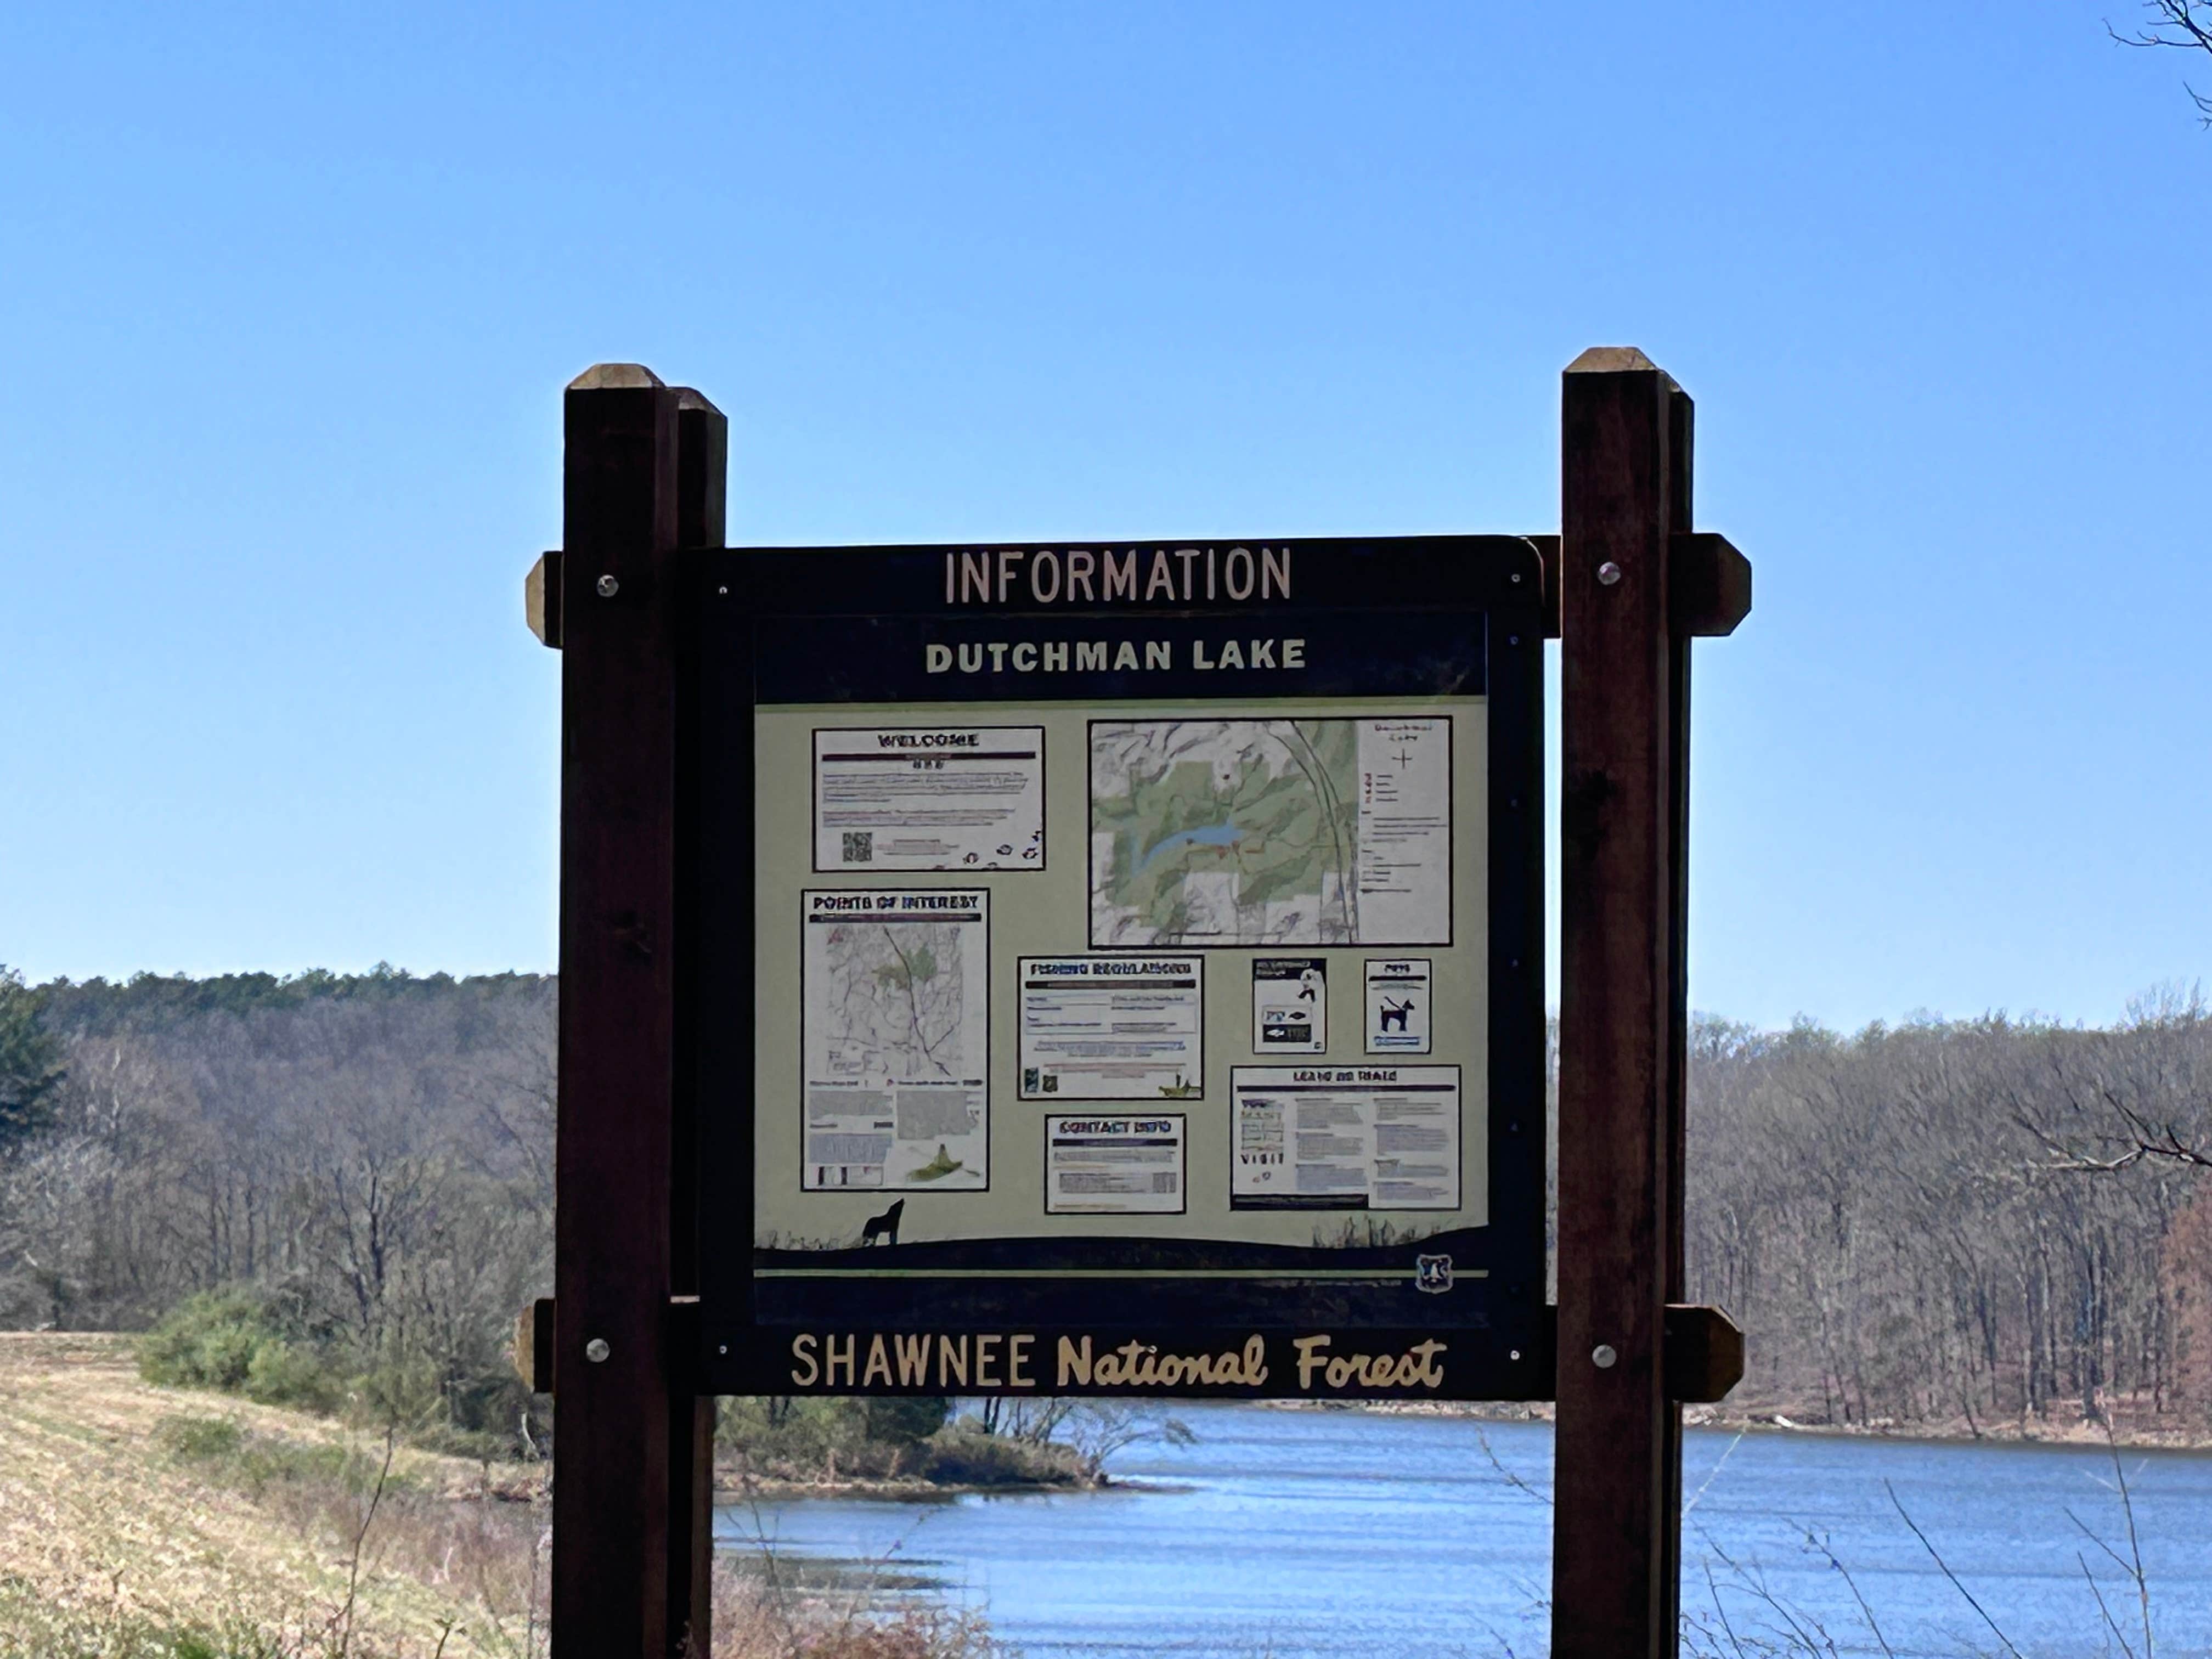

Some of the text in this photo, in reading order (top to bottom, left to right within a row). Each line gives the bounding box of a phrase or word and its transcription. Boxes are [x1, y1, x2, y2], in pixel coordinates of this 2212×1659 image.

[945, 547, 1291, 604] INFORMATION
[926, 638, 1306, 674] DUTCHMAN LAKE
[877, 733, 980, 747] WELCOME
[791, 1333, 1448, 1390] SHAWNEE National Forest
